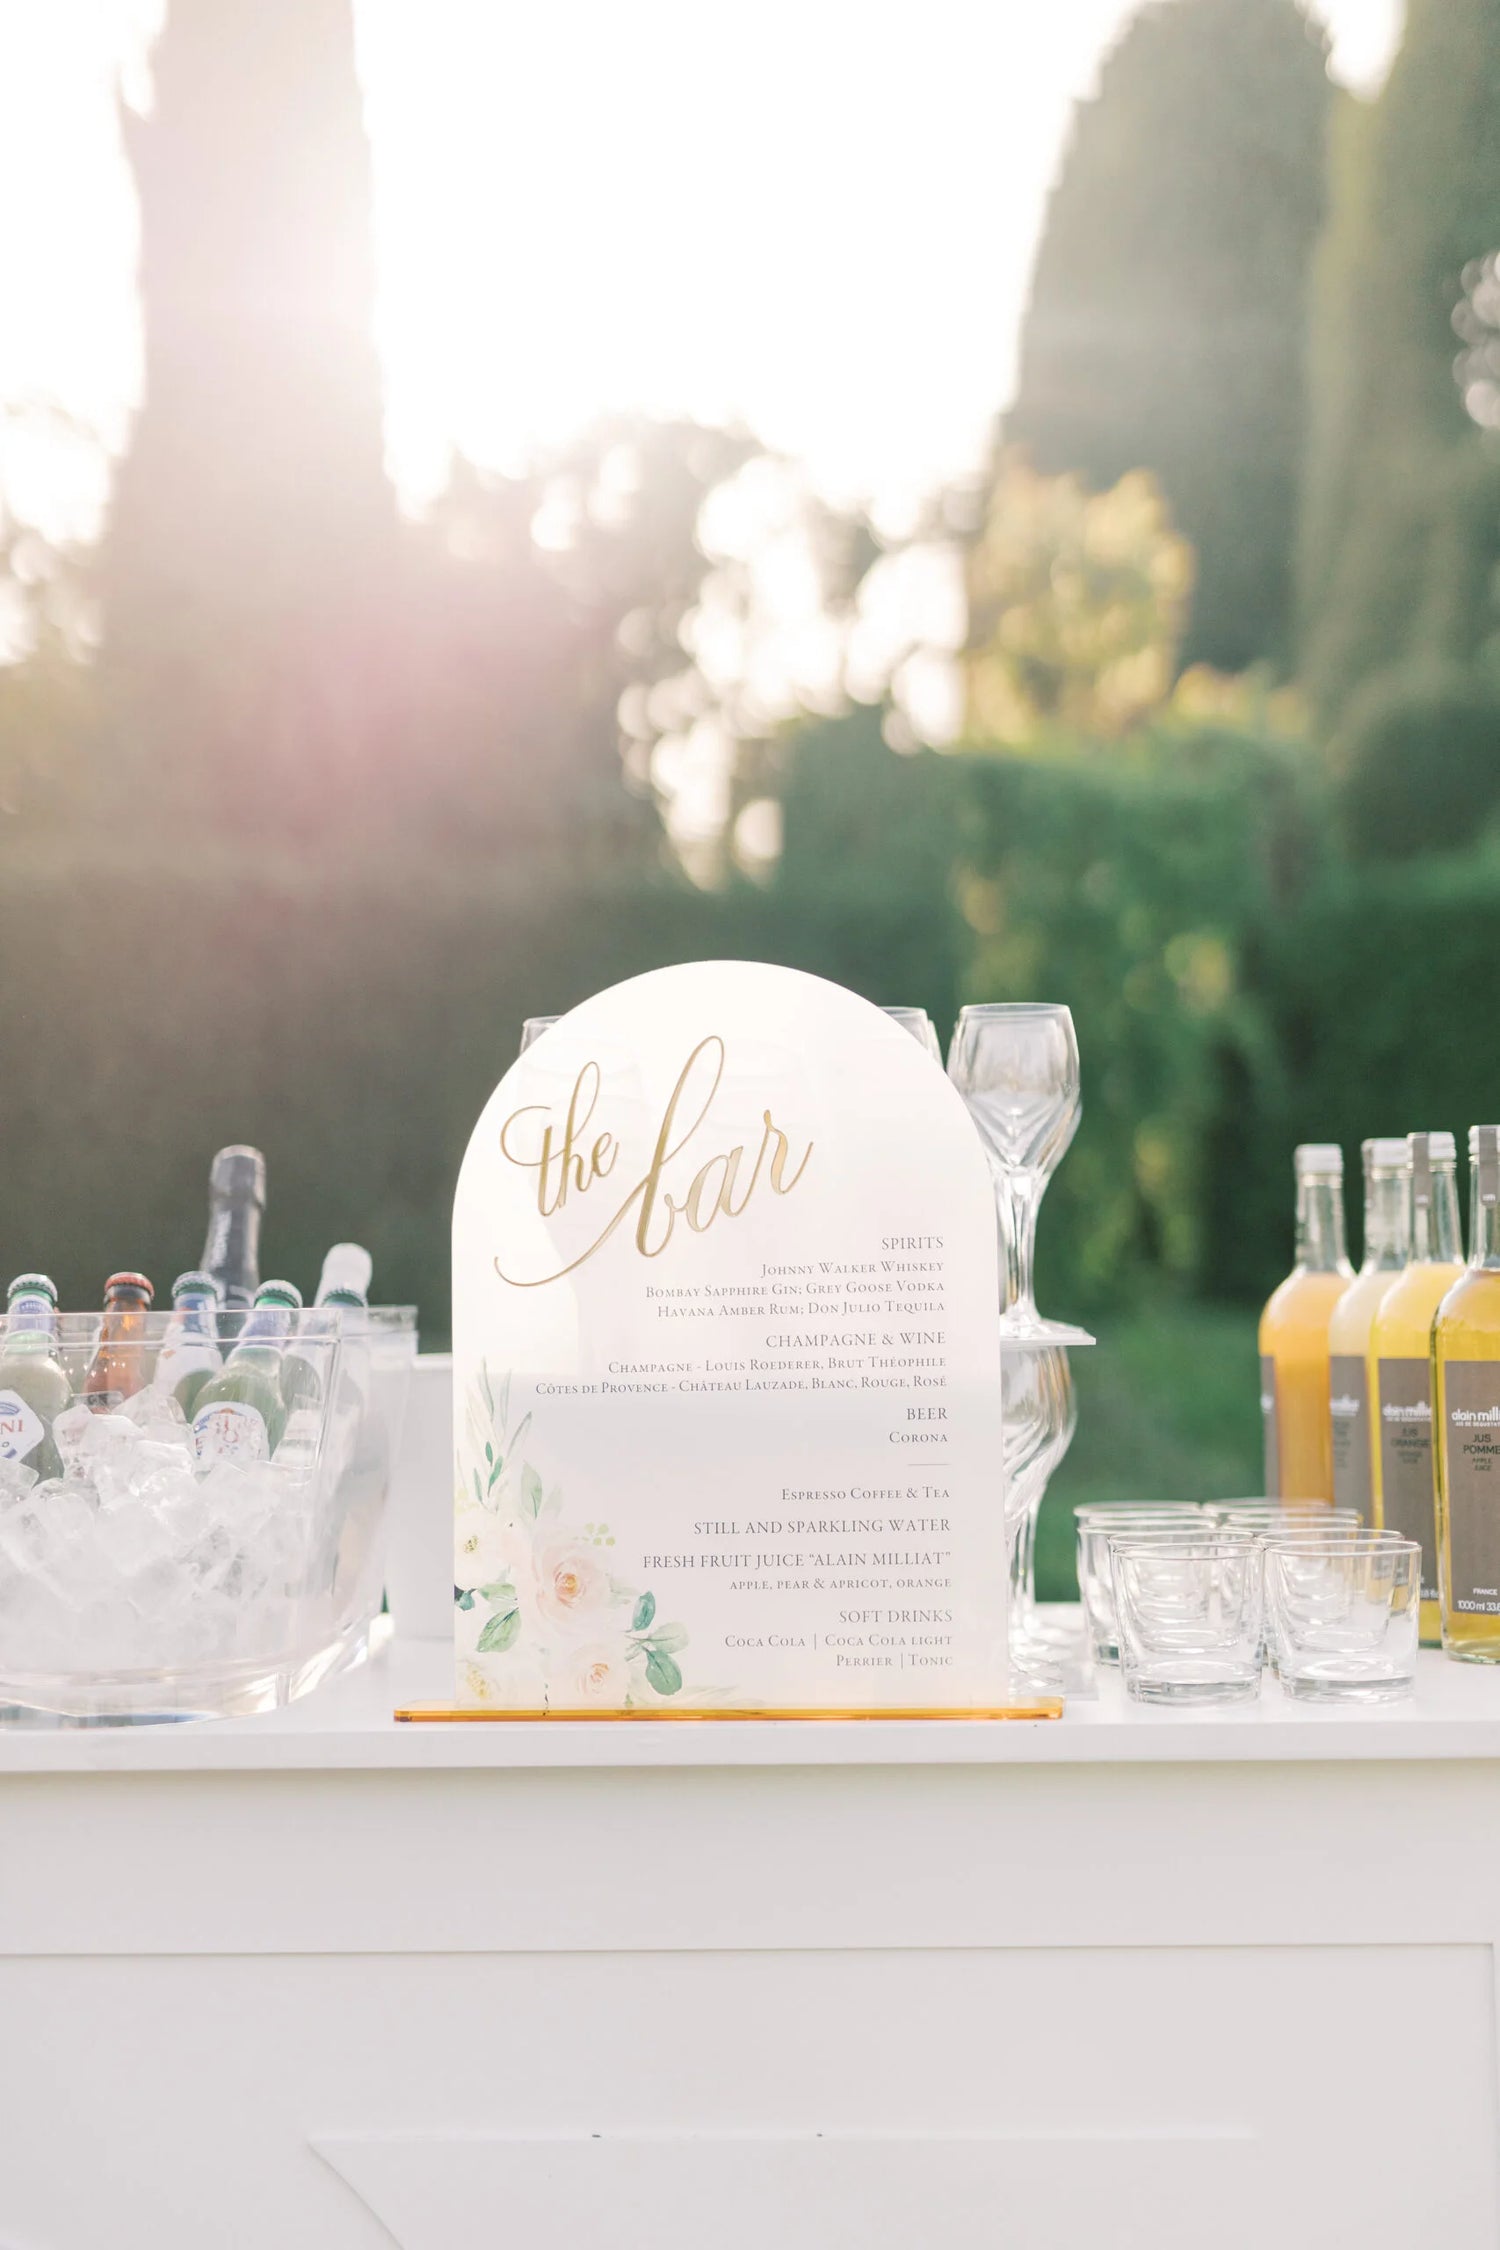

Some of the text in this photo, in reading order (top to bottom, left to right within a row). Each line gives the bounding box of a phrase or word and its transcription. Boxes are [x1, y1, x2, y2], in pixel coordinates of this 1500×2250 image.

[501, 1061, 619, 1217] the
[881, 1236, 944, 1250] SPIRITS
[765, 1331, 945, 1348] CHAMPAGNE & WINE
[906, 1407, 948, 1421] BEER
[1452, 1408, 1477, 1421] alain
[1473, 1434, 1492, 1443] JUS
[1463, 1444, 1500, 1455] POMME
[906, 1487, 918, 1499] &
[694, 1518, 950, 1535] STILL AND SPARKLING WATER
[643, 1555, 695, 1569] FRESH
[701, 1554, 752, 1568] FRUIT
[755, 1554, 804, 1570] JUICE
[813, 1577, 825, 1590] &
[1472, 1587, 1498, 1596] FRANCE
[1457, 1600, 1475, 1611] 1000
[1476, 1602, 1486, 1611] ml
[839, 1609, 953, 1623] SOFT DRINKS
